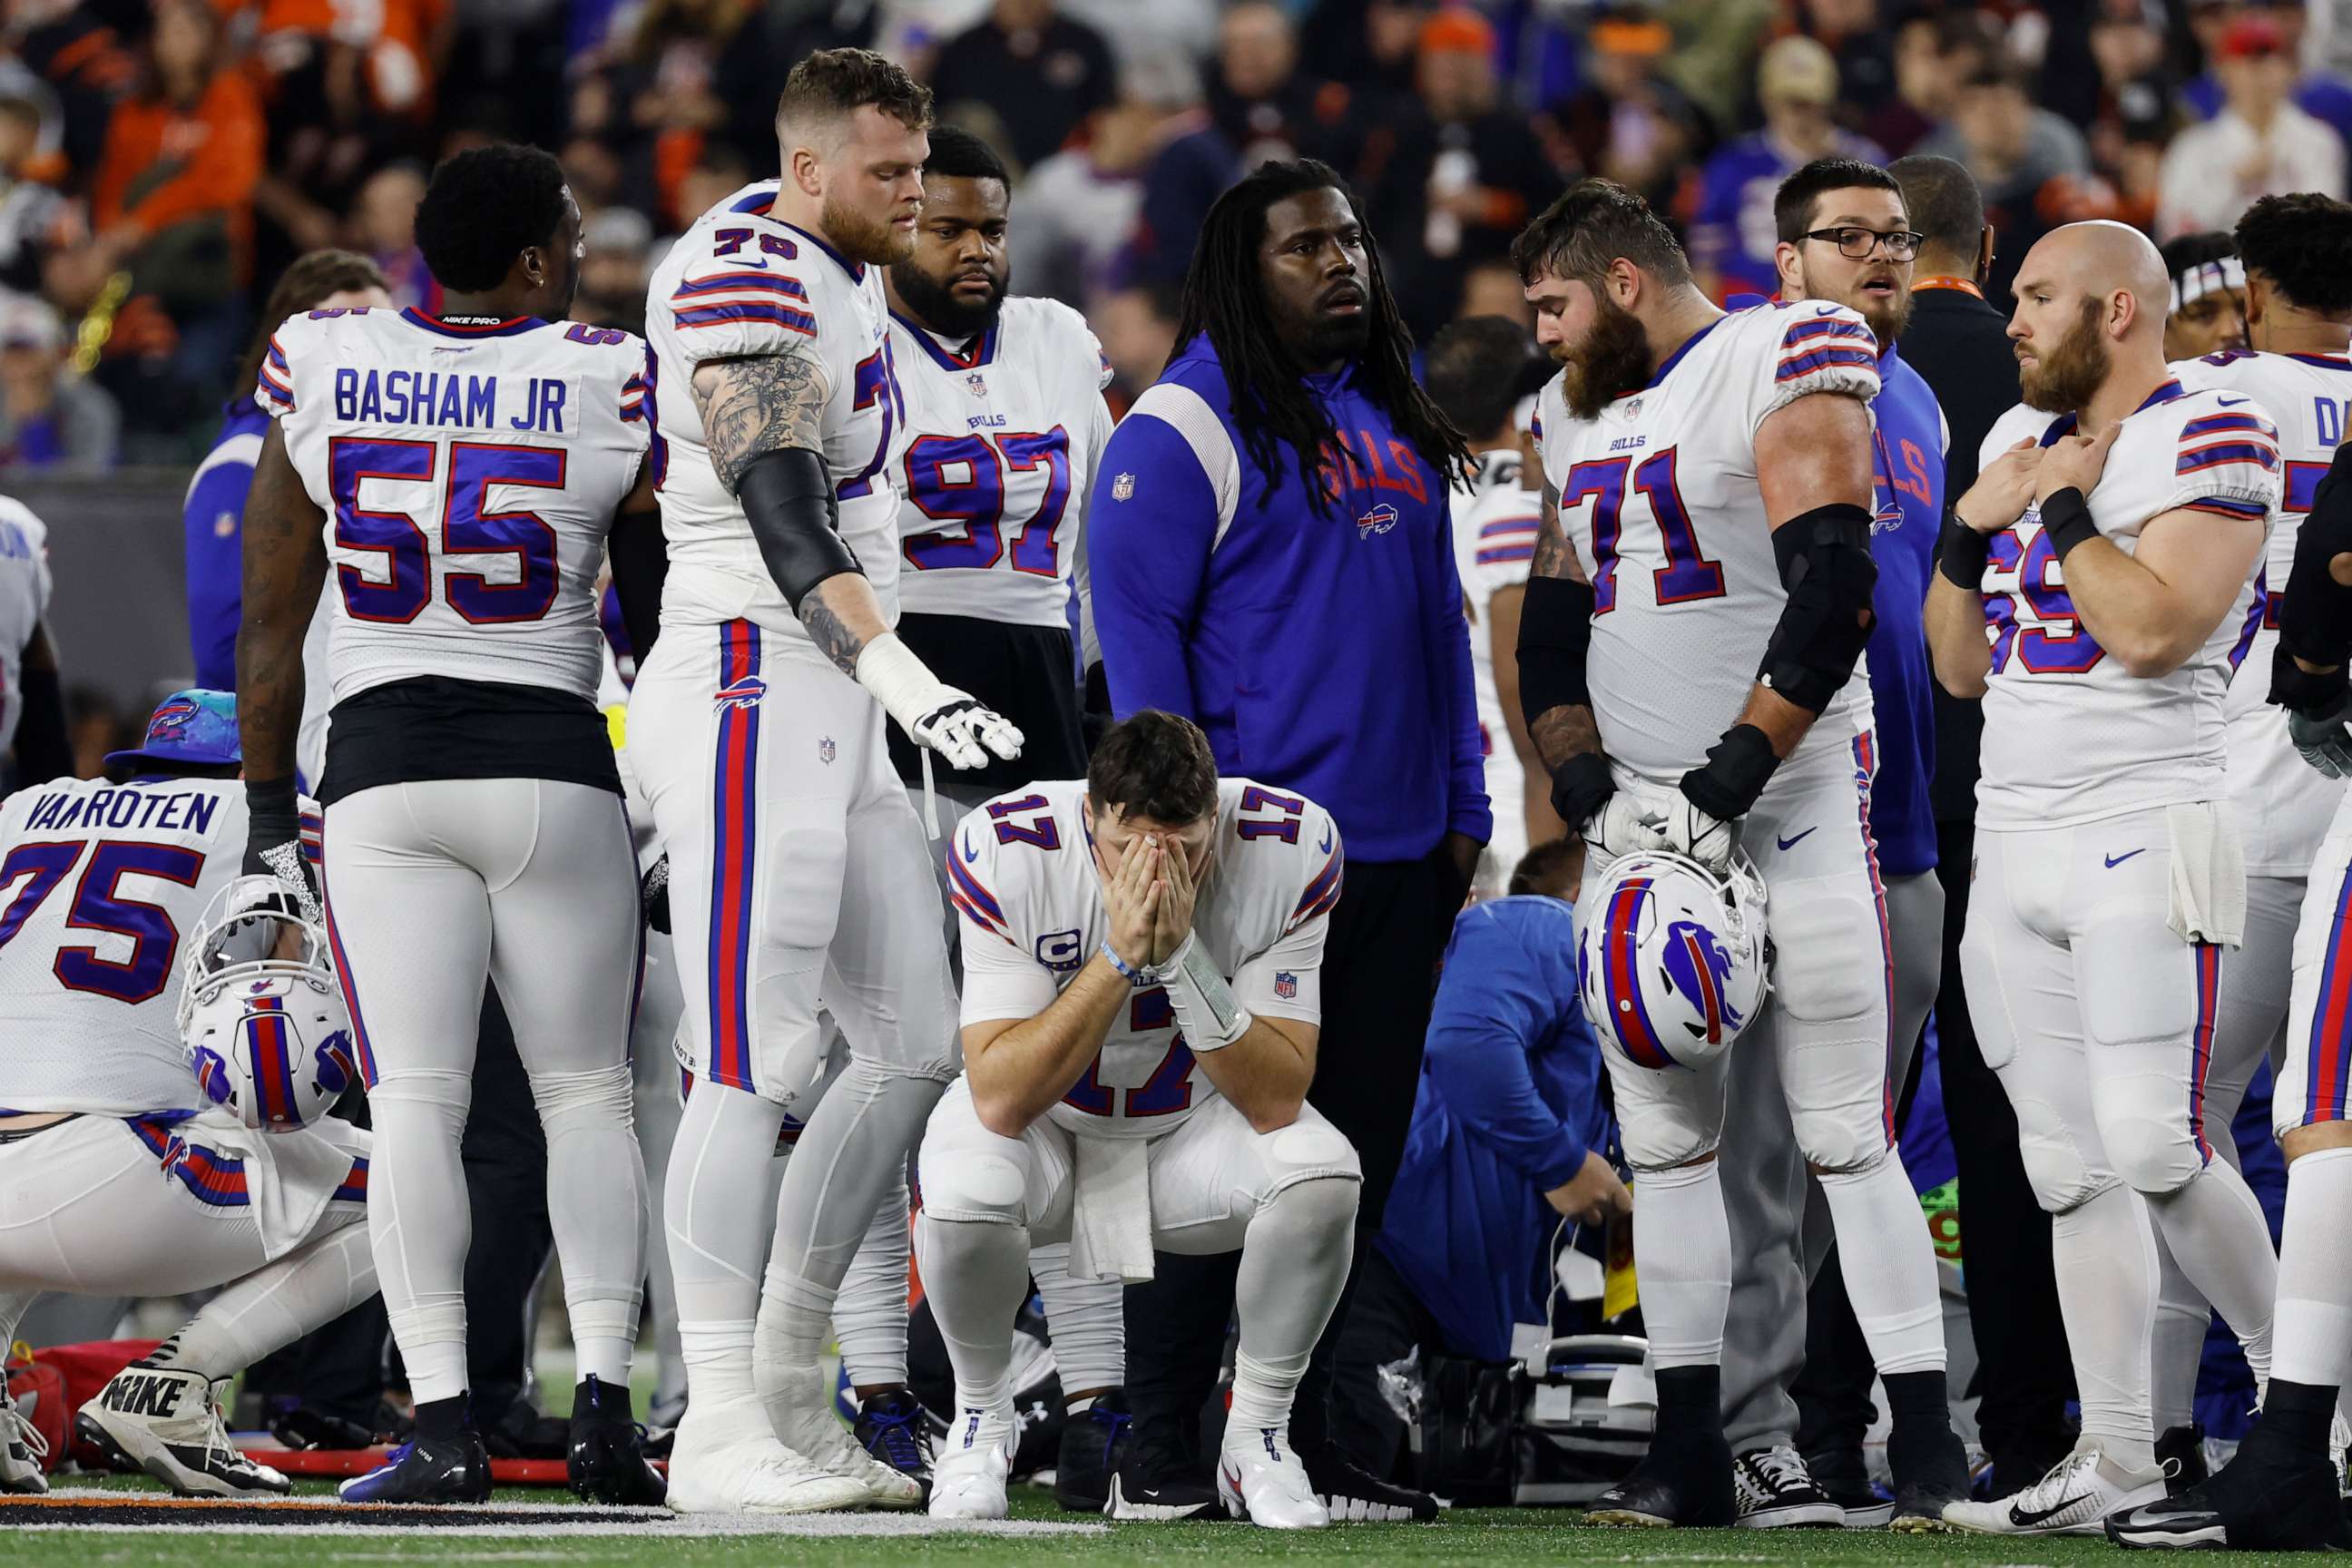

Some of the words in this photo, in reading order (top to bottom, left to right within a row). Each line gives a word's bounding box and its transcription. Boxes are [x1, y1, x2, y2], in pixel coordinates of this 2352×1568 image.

[442, 316, 469, 325] NIKE
[471, 317, 500, 326] PRO
[335, 368, 496, 429] BASHAM
[510, 377, 566, 433] JR
[966, 414, 1006, 428] BILLS
[2315, 397, 2352, 446] D
[1318, 430, 1427, 505] BLLS
[1610, 436, 1646, 450] BILLS
[328, 436, 568, 624] 55
[903, 423, 1072, 579] 97
[1562, 444, 1727, 620] 71
[985, 794, 1062, 851] 17
[1237, 786, 1304, 846] 17
[0, 839, 207, 1005] 75
[100, 1375, 189, 1418] NIKE
